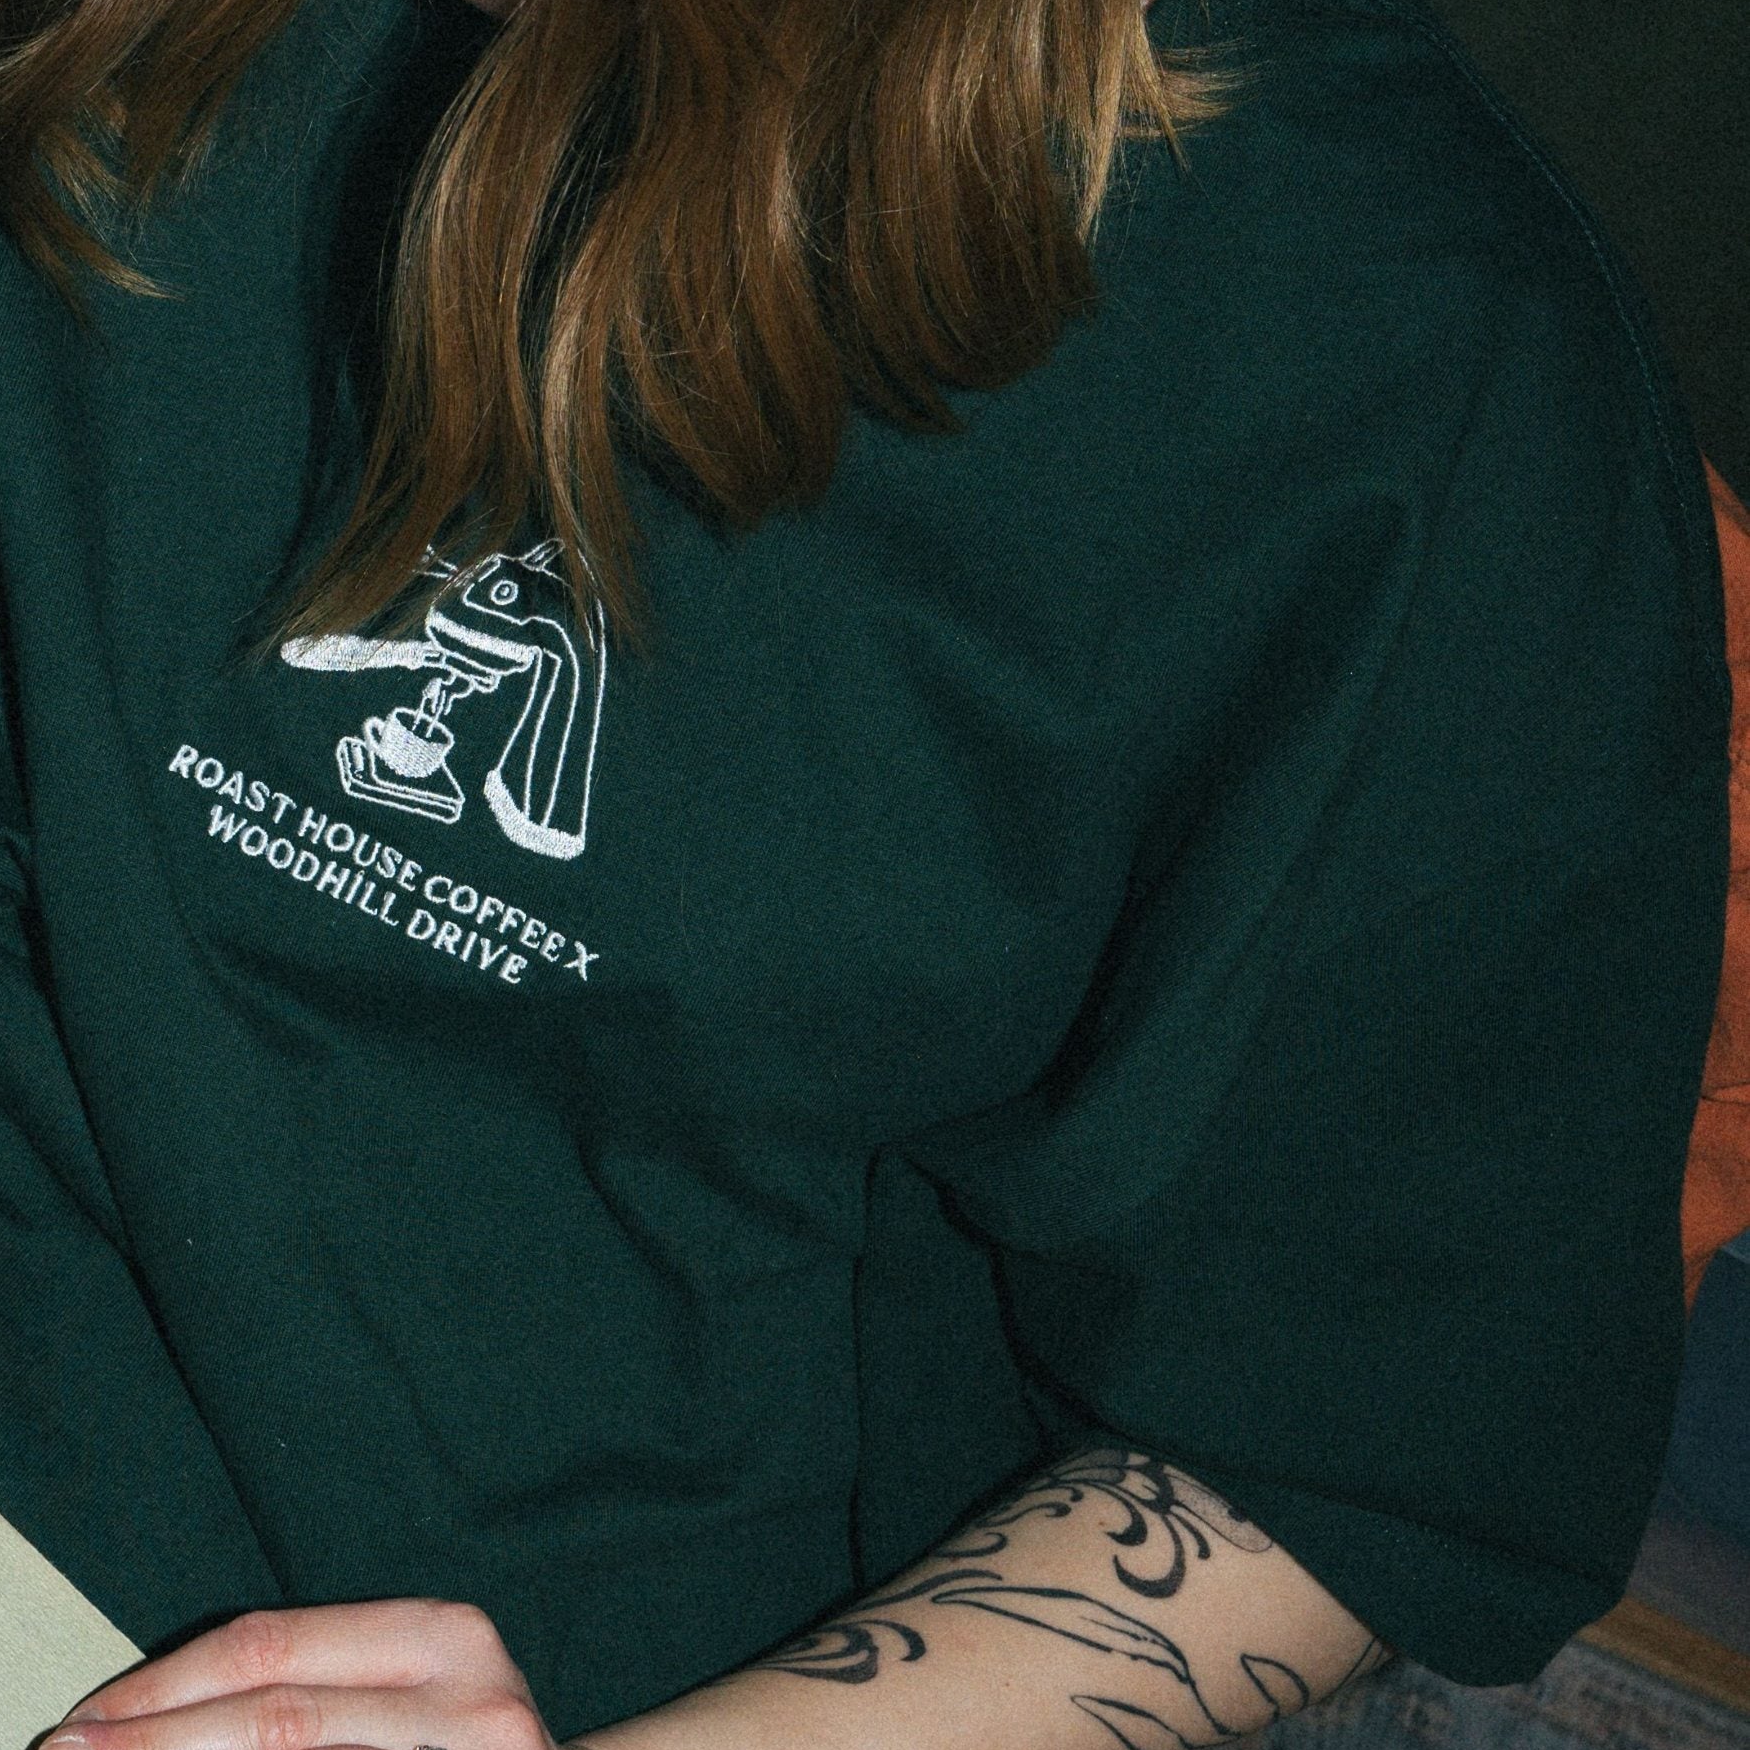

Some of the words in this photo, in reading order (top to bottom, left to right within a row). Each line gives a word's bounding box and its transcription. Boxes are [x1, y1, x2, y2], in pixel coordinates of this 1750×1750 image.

[168, 744, 297, 823] ROAST
[298, 806, 423, 892] HOUSE
[424, 875, 567, 963] COFFEE
[563, 941, 600, 982] X
[207, 803, 401, 928] WOODHILL
[406, 909, 529, 985] DRIVE
